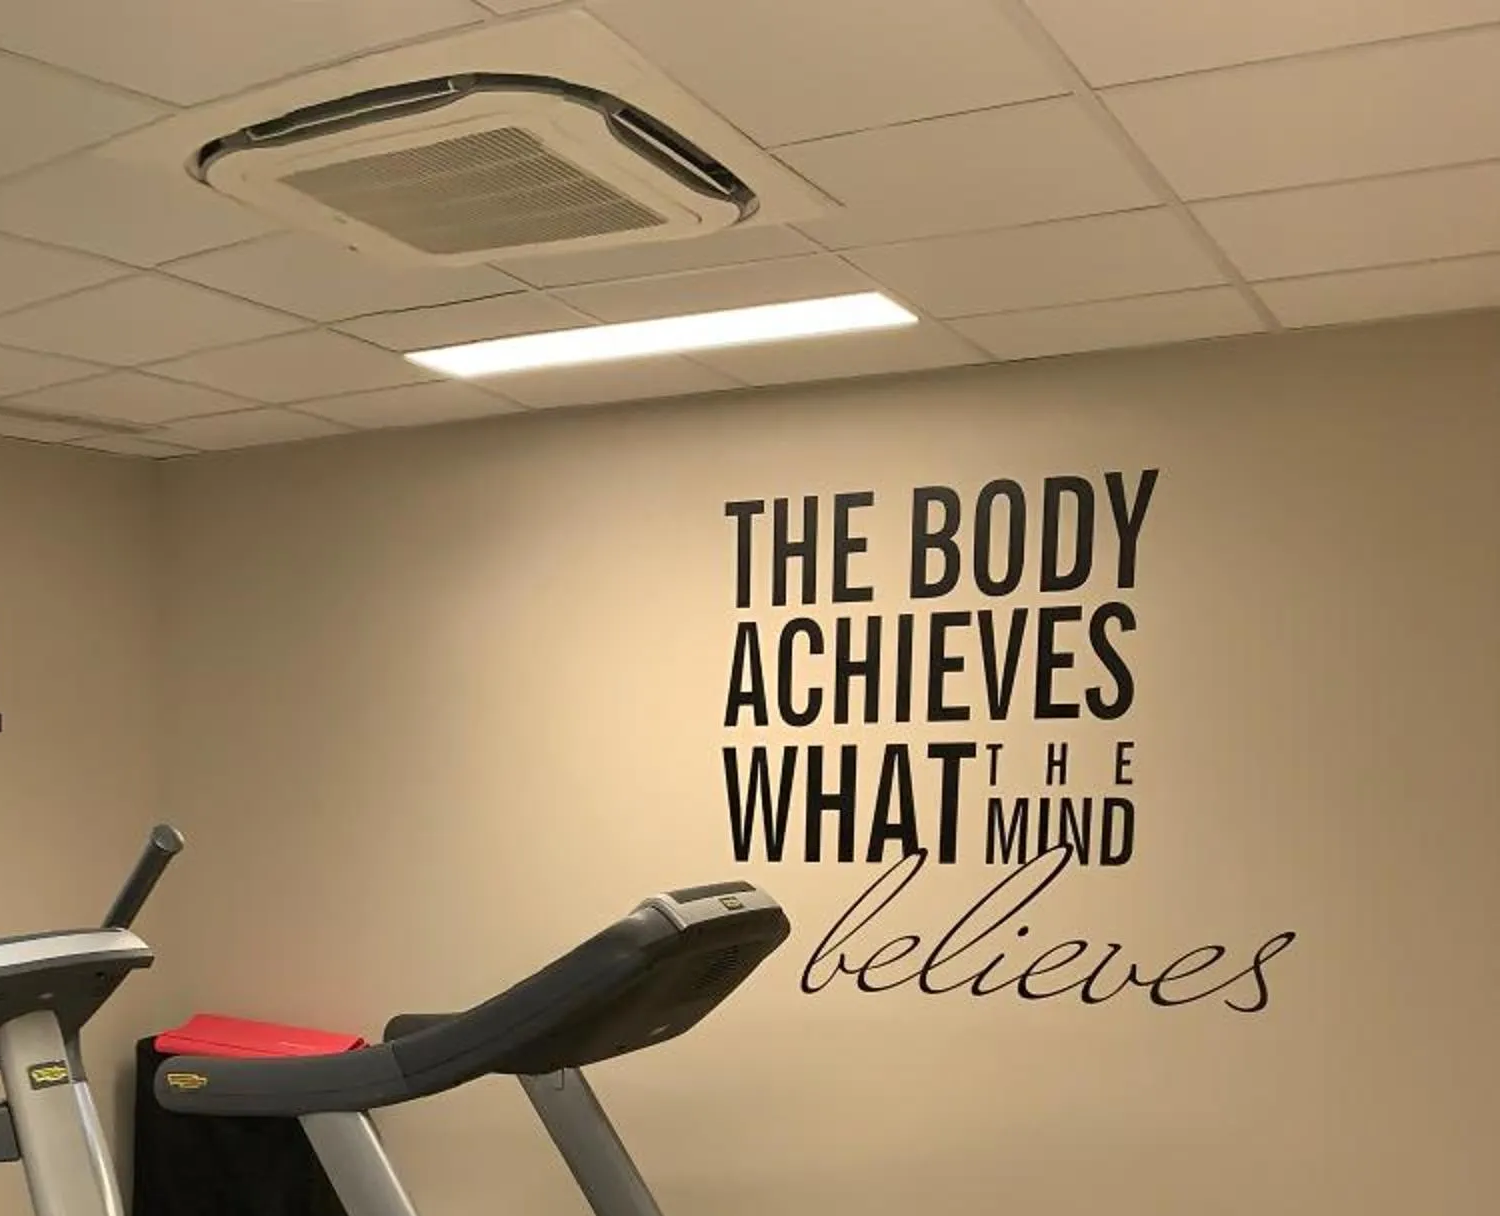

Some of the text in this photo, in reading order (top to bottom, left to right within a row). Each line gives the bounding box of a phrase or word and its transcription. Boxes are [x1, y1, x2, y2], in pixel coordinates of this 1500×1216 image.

[724, 469, 1160, 609] THE BODY
[723, 602, 1137, 727] ACHIEVES
[722, 742, 977, 864] WHAT
[985, 741, 1135, 786] THE
[985, 797, 1135, 867] MIND
[800, 841, 1296, 1013] believes
